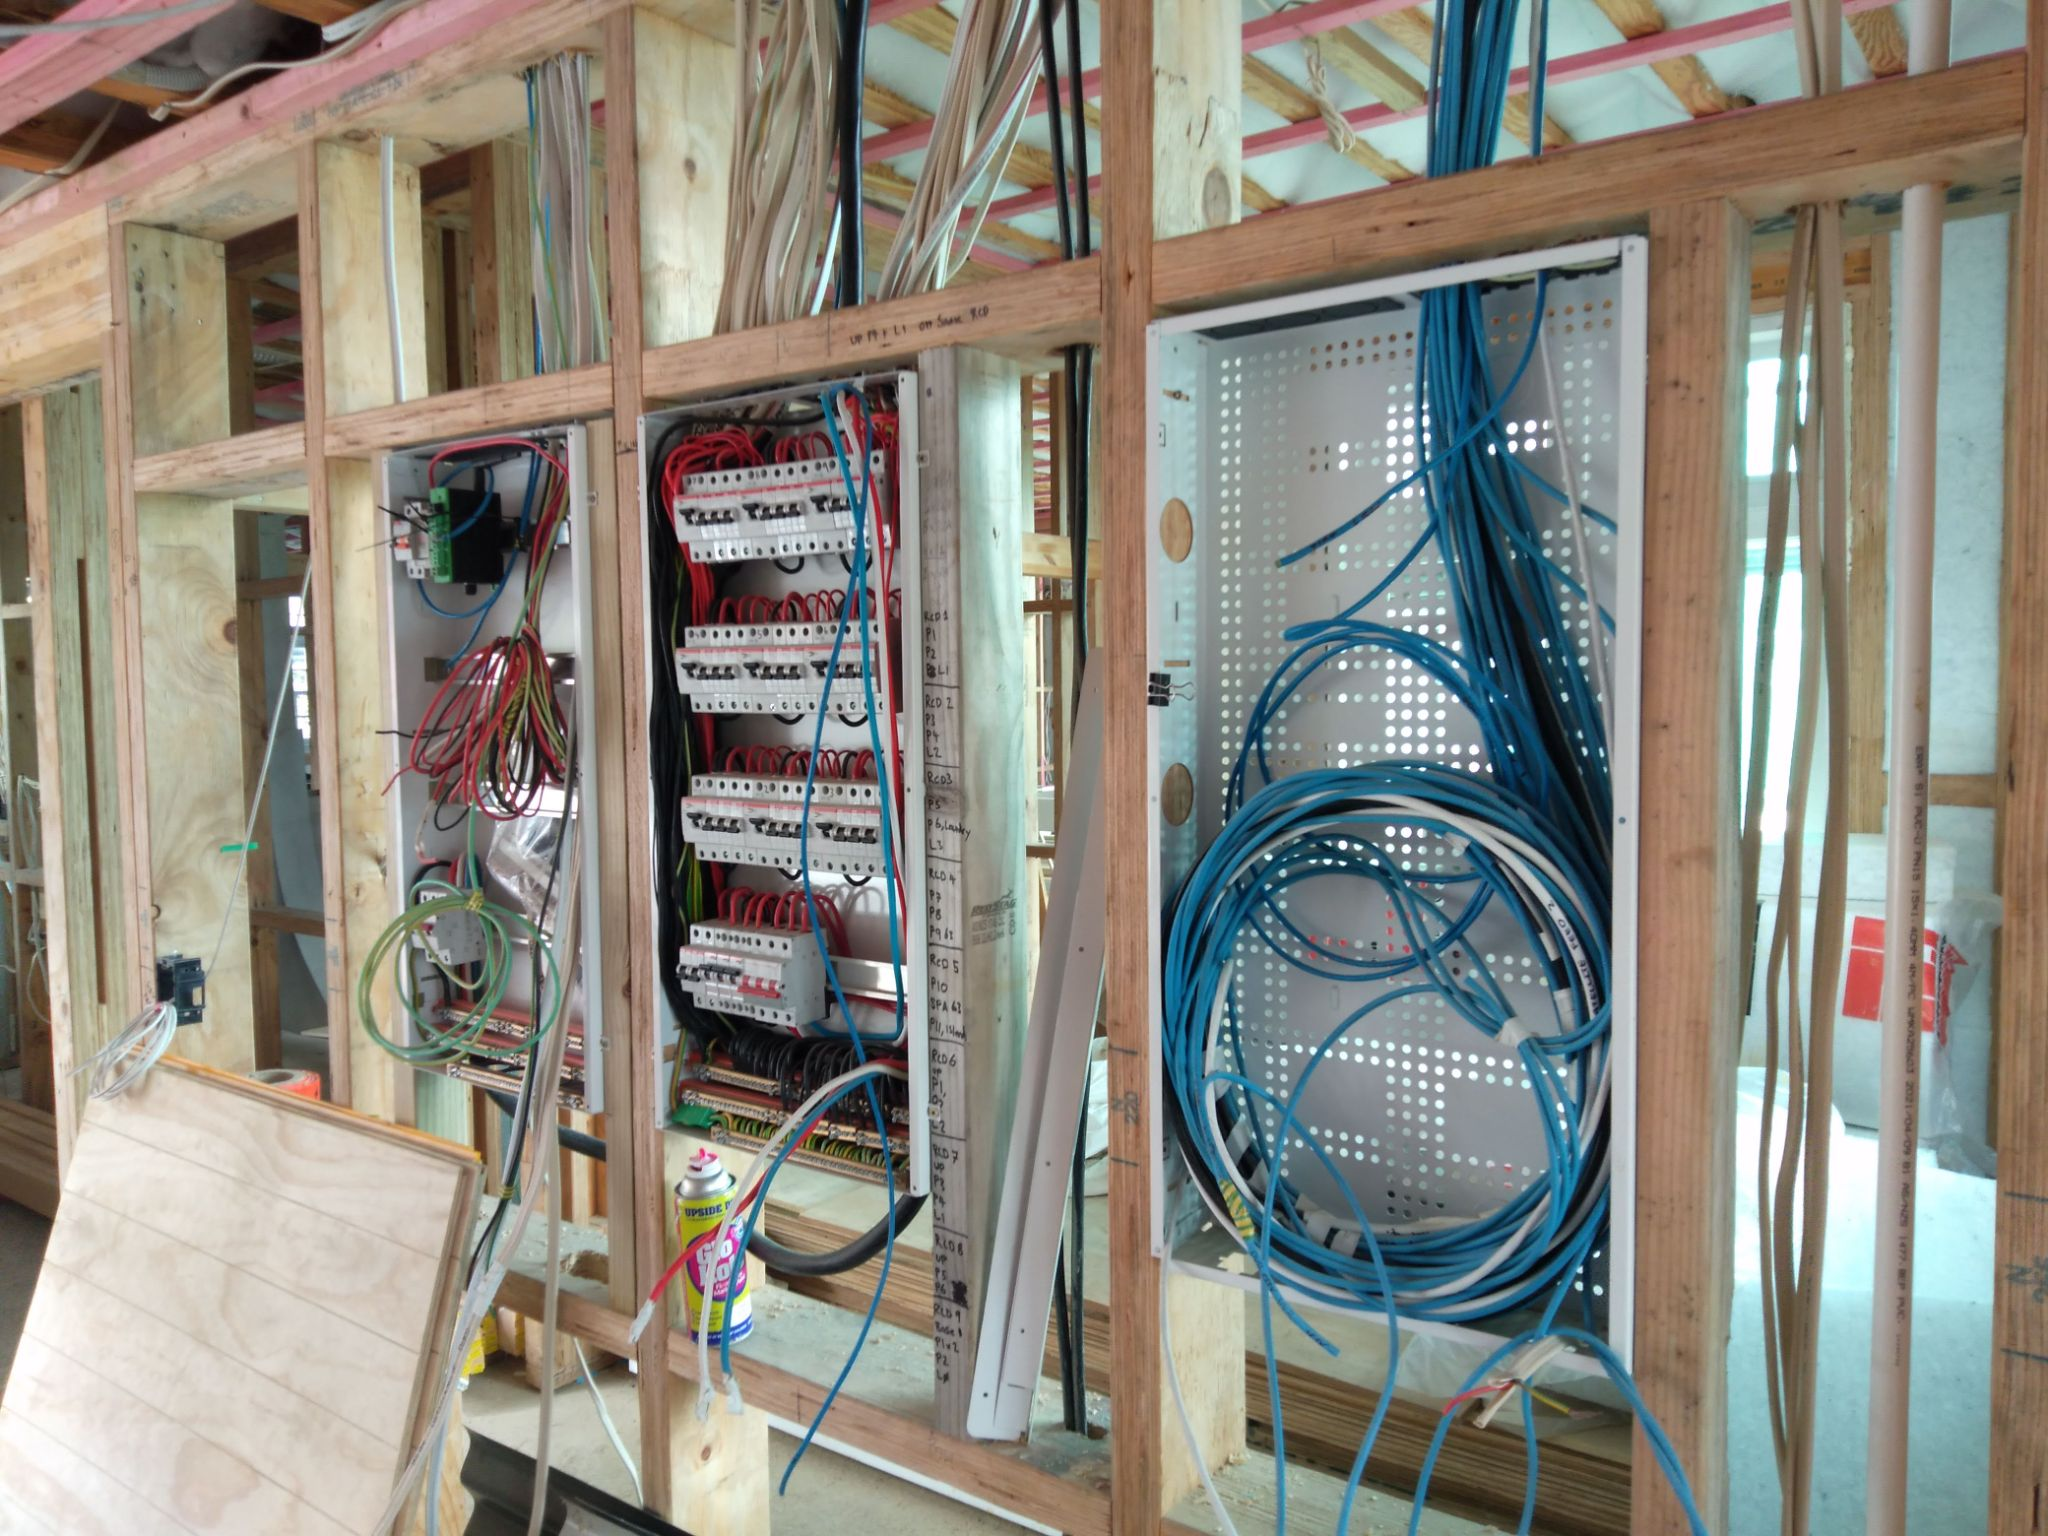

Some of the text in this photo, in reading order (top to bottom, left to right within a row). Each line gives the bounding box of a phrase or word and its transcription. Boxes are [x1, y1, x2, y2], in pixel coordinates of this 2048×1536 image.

[926, 627, 936, 641] P1
[926, 646, 936, 659] P2
[946, 697, 954, 709] 2
[925, 713, 936, 726] P3
[926, 729, 939, 742] P4
[926, 746, 942, 758] L2
[929, 838, 944, 850] L3
[949, 873, 956, 885] 4
[929, 889, 941, 903] P7
[929, 906, 941, 920] P8
[930, 925, 941, 940] P9
[952, 960, 959, 973] 5
[930, 976, 948, 993] P10
[930, 997, 948, 1012] SPA
[952, 1150, 959, 1164] 7
[685, 1204, 722, 1217] UPSIDE
[934, 1208, 945, 1224] L1
[936, 1254, 948, 1265] UP
[935, 1267, 946, 1280] P5
[935, 1281, 946, 1294] P6
[936, 1352, 949, 1366] P2
